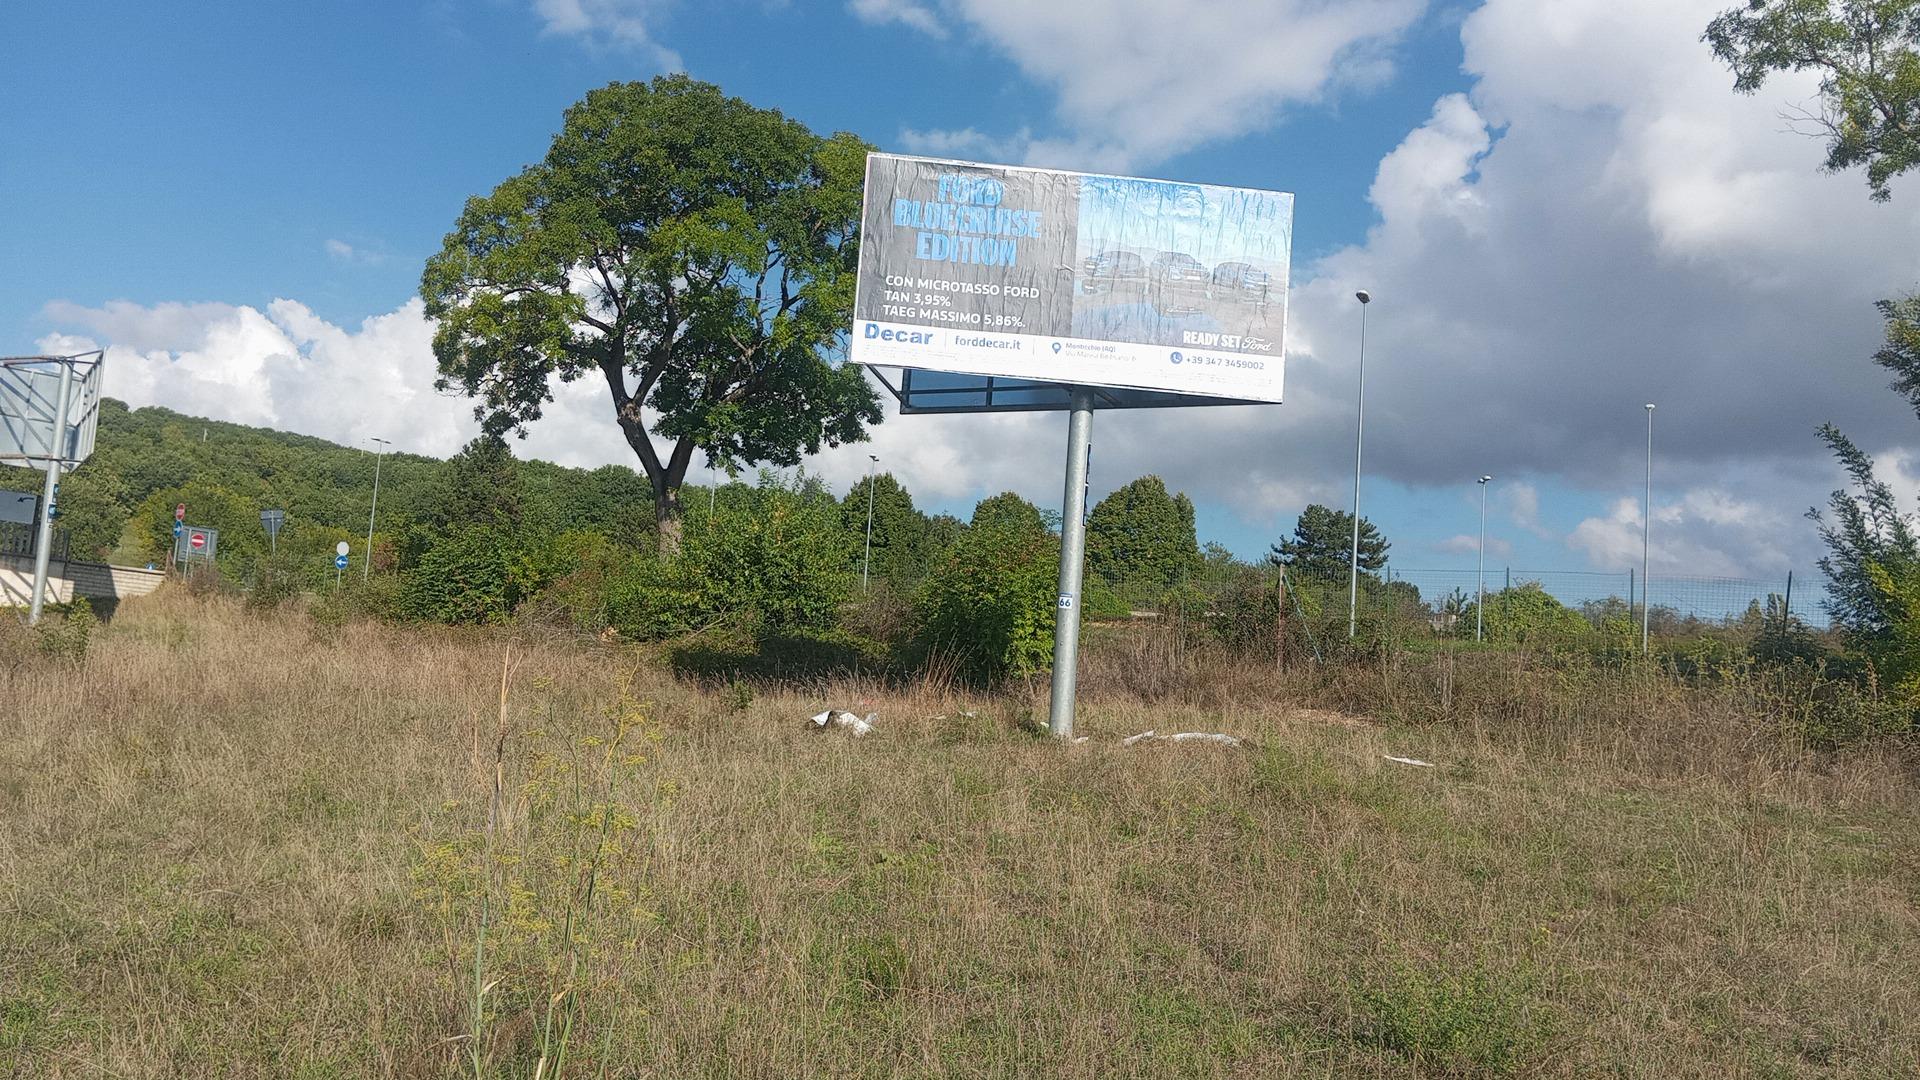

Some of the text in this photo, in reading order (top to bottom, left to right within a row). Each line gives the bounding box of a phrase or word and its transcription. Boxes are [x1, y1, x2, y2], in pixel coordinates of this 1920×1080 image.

[937, 174, 1005, 206] FORD
[893, 198, 1043, 239] BLUECRUISE
[916, 231, 1017, 268] EDITION
[885, 275, 1040, 299] CON MICROTASSO FORD
[884, 290, 951, 307] TAN 3,95%
[883, 304, 1026, 328] TAEG MASSIMO 5,86%.
[864, 323, 934, 345] Decar
[955, 335, 1021, 351] forddecar.it
[1183, 330, 1275, 351] READY SET Ford
[1186, 355, 1265, 370] +39 347 3459002
[1059, 598, 1071, 607] 66
